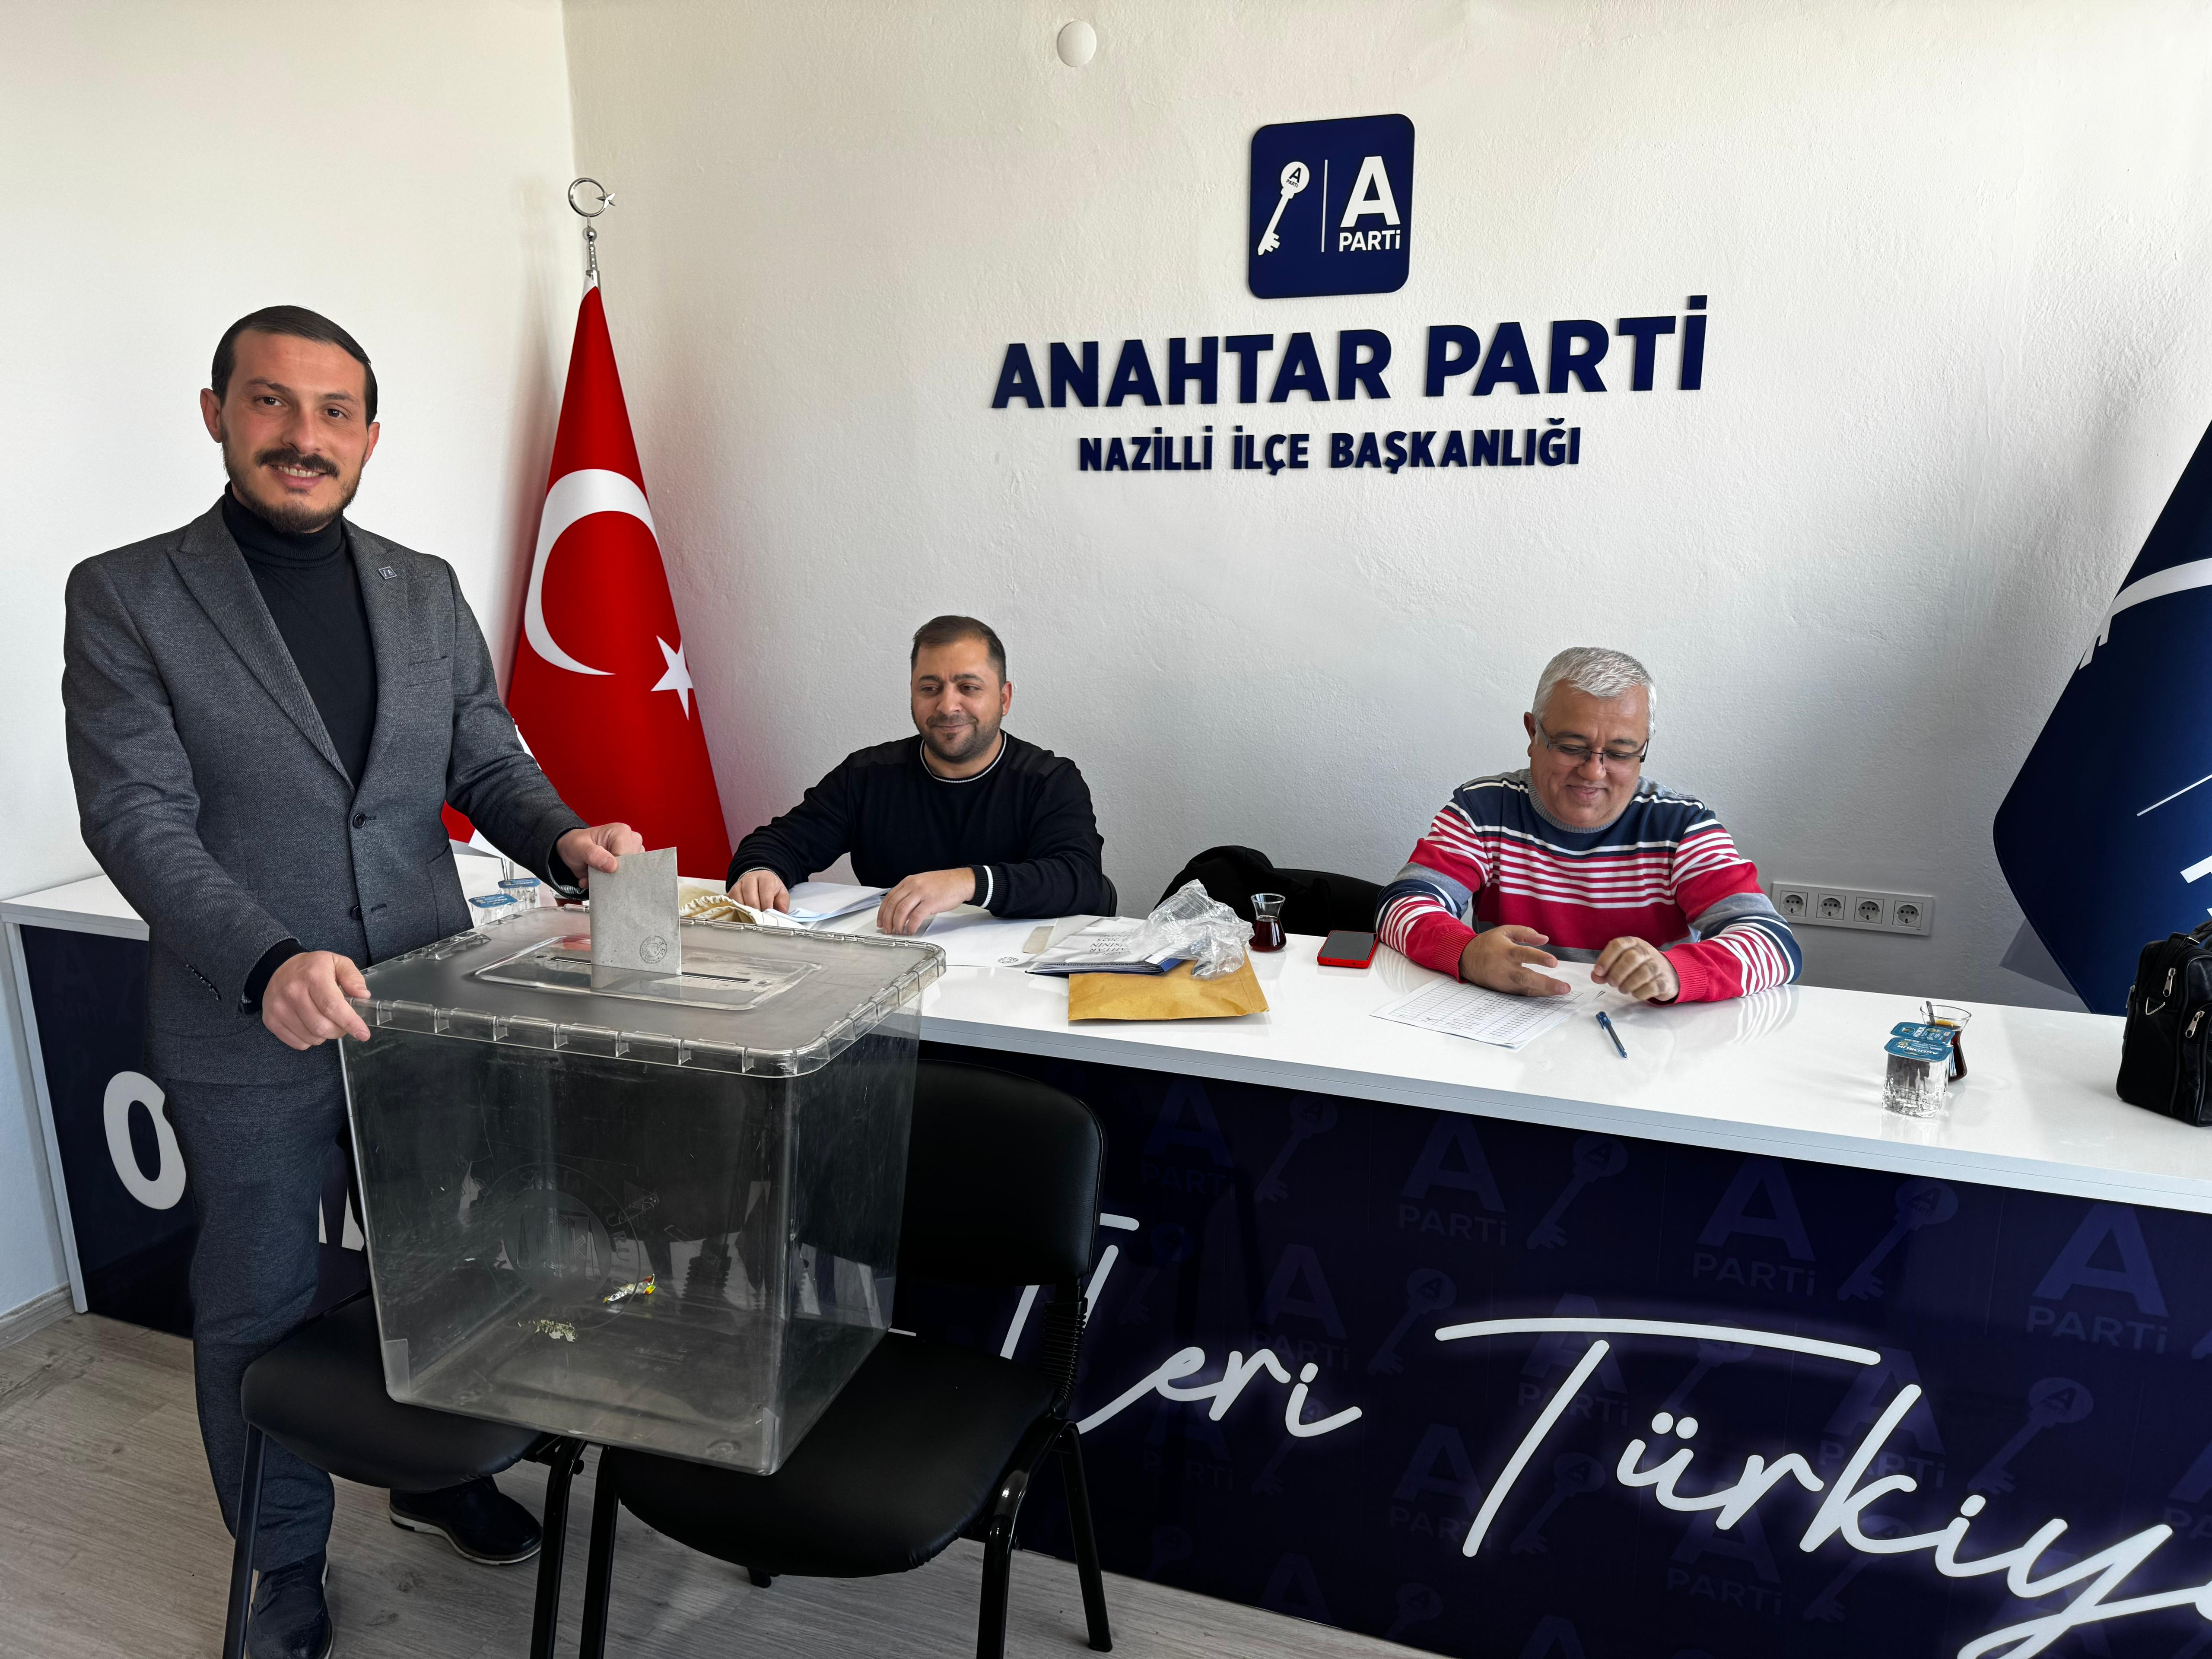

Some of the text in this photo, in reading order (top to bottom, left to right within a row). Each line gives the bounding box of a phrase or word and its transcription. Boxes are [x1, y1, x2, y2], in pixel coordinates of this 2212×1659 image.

[1289, 167, 1301, 183] A
[1340, 156, 1401, 228] A
[991, 295, 1708, 409] ANAHTAR PARTİ
[1080, 417, 1581, 476] NAZİLLİ İLÇE BAŞKANLIĞI
[1401, 1112, 1506, 1212] A
[1696, 1154, 1815, 1262] A
[2032, 1202, 2169, 1318] A
[1435, 1318, 2212, 1659] Türkiy
